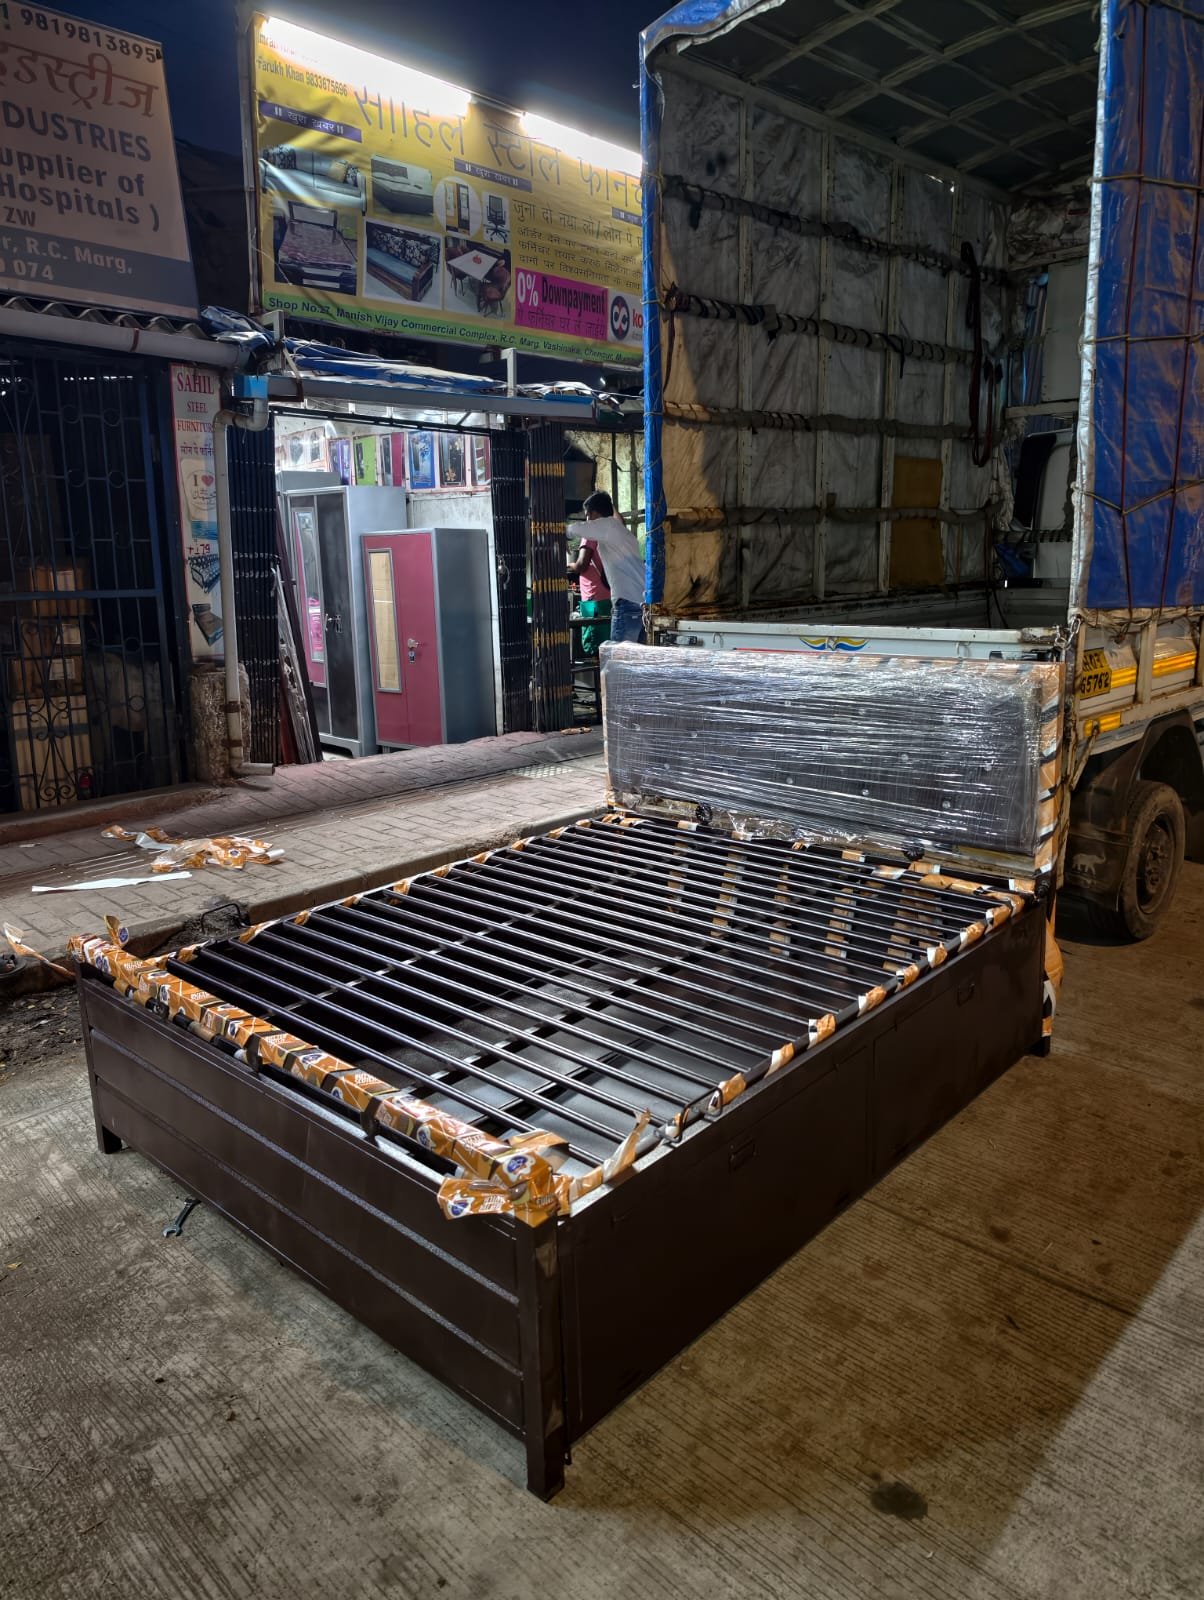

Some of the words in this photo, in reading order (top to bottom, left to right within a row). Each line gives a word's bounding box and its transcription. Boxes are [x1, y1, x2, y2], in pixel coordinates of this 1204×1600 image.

[20, 8, 157, 64] 9819813895
[285, 63, 305, 83] Khan
[4, 101, 152, 162] DUSTRIES
[118, 174, 145, 197] of
[14, 260, 54, 281] 074
[516, 271, 539, 307] 0%
[541, 276, 606, 318] Downpayment
[268, 297, 298, 311] Shop
[335, 307, 373, 323] Manish
[374, 315, 399, 330] Vijay
[401, 319, 457, 336] Commercial
[176, 371, 216, 395] SAHIL
[186, 401, 208, 414] STEEL
[176, 419, 214, 433] FURNITUR
